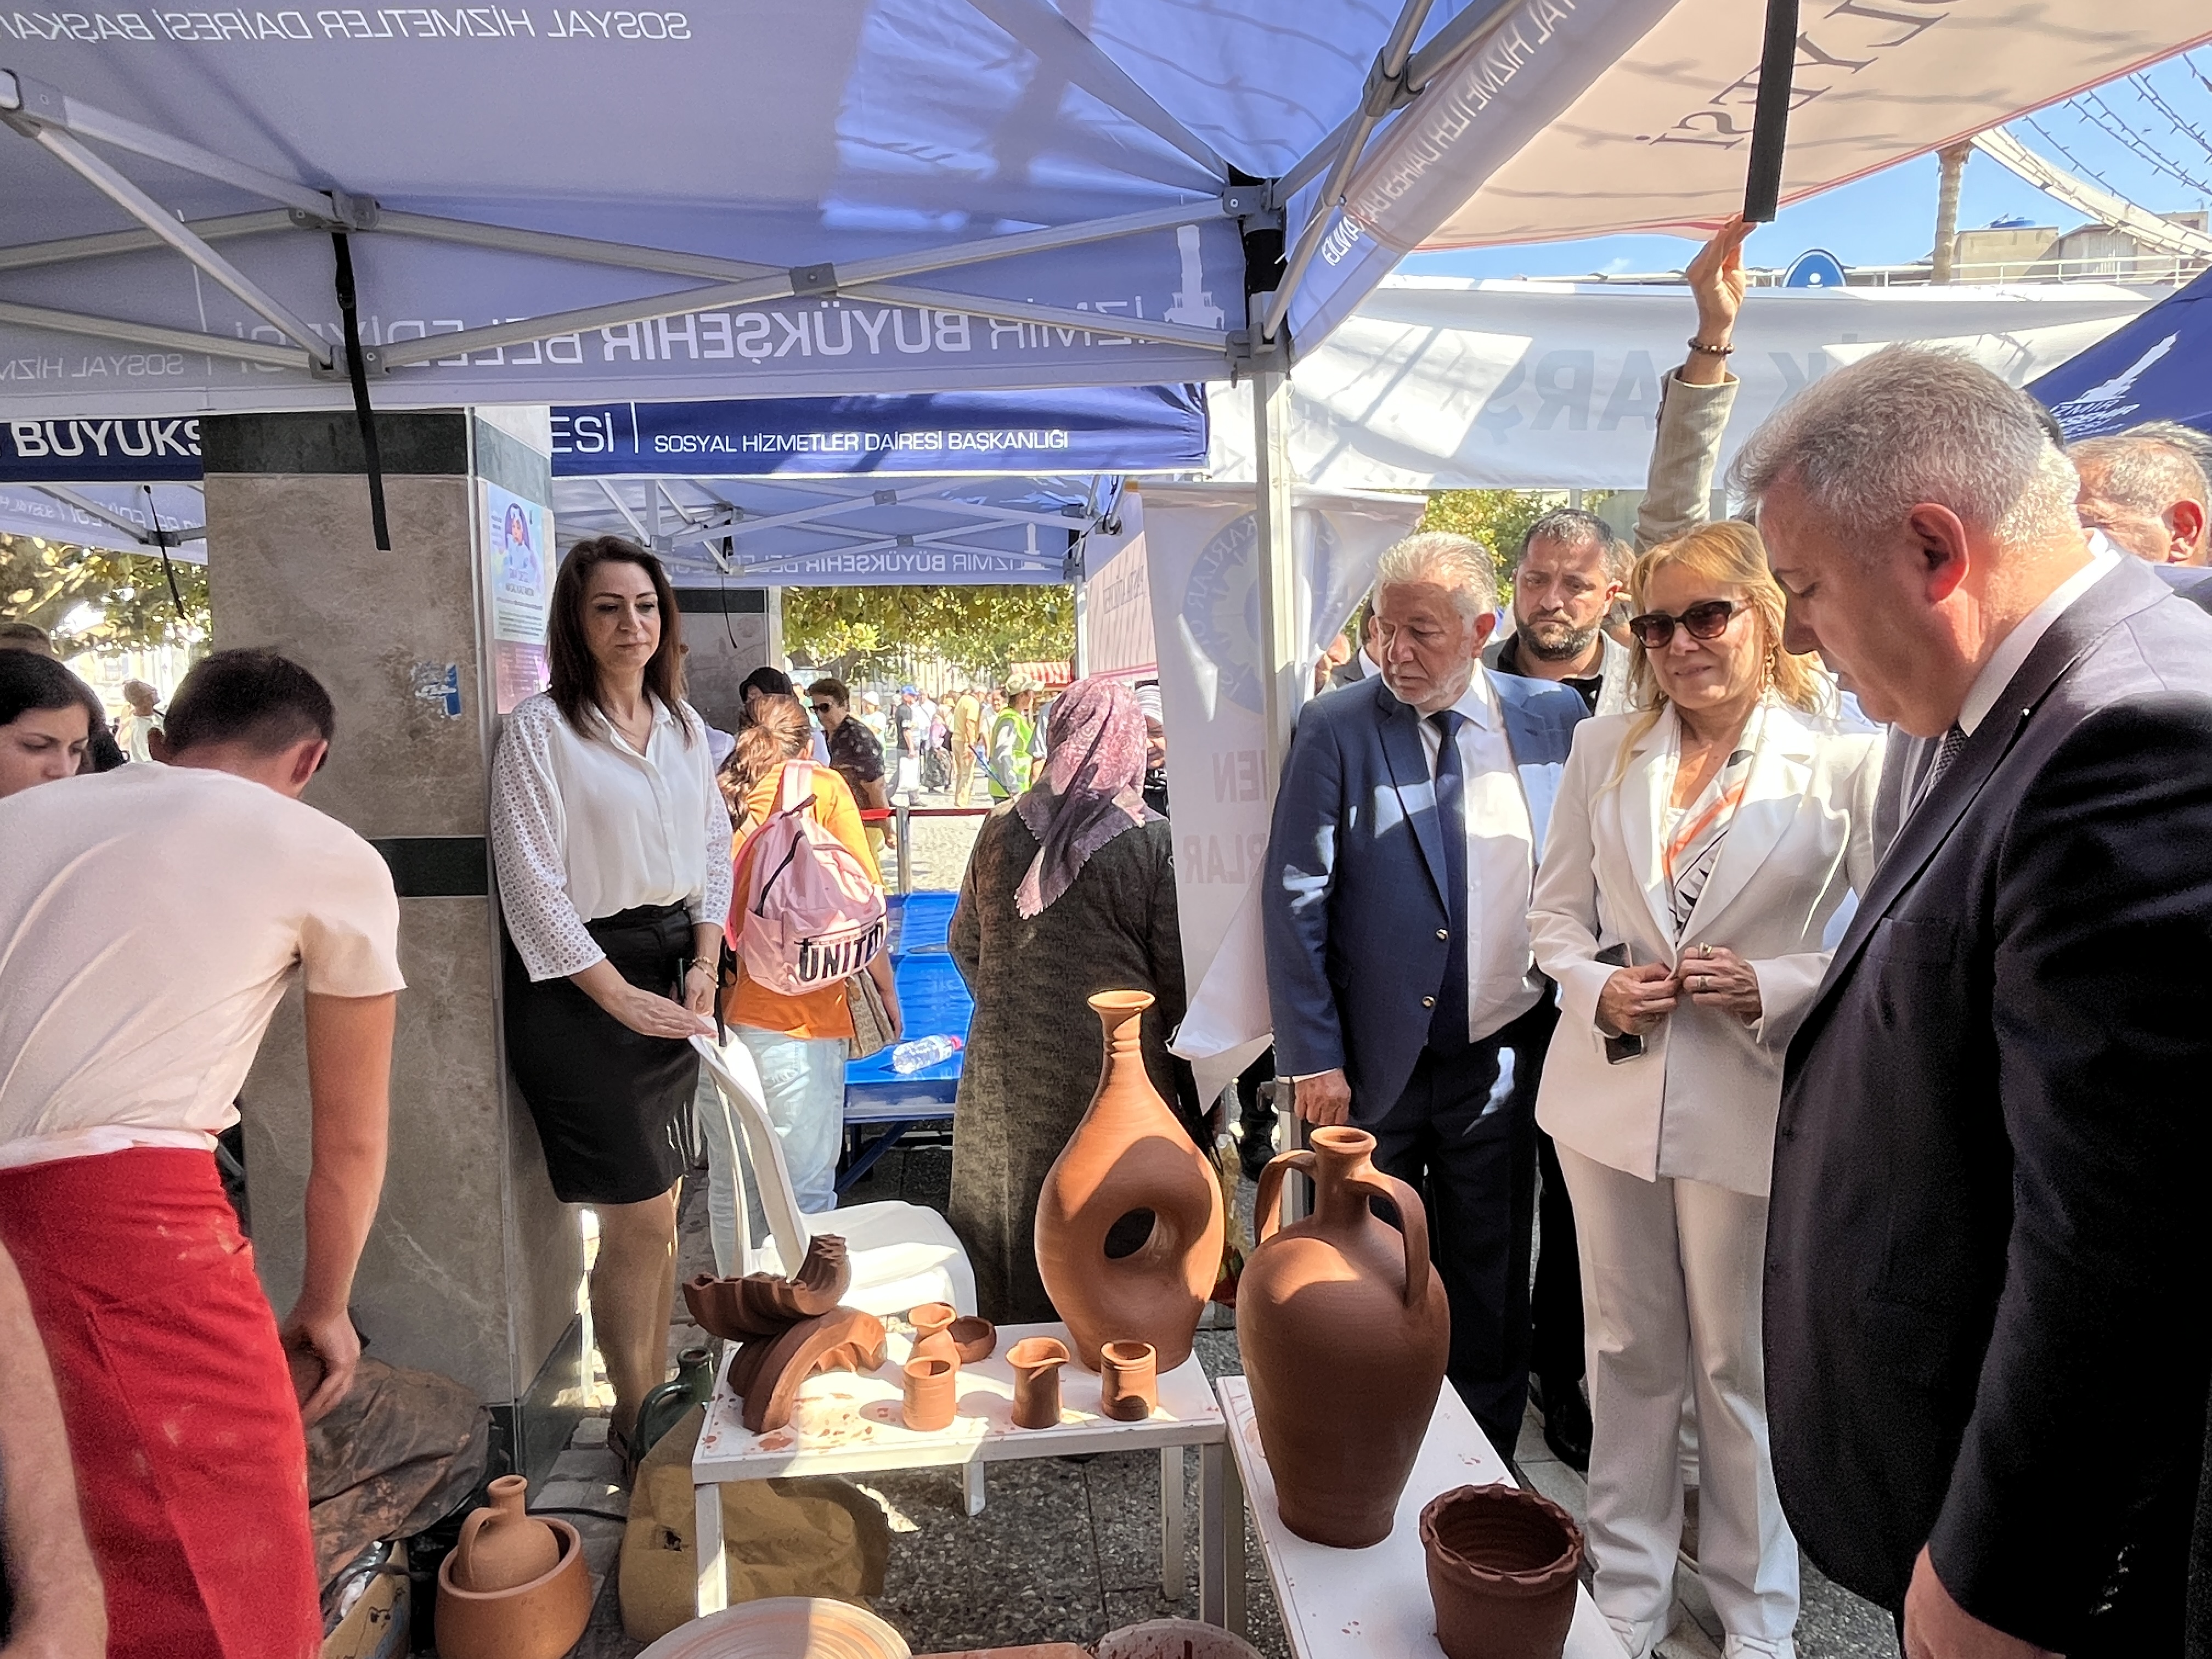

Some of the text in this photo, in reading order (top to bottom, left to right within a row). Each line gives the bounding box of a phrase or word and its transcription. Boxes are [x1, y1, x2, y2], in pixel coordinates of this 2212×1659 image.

[654, 435, 737, 453] SOSYAL
[742, 432, 860, 453] HİZMETLER
[865, 431, 943, 451] DAİRESİ
[948, 429, 1069, 453] BAŞKANLIĞI
